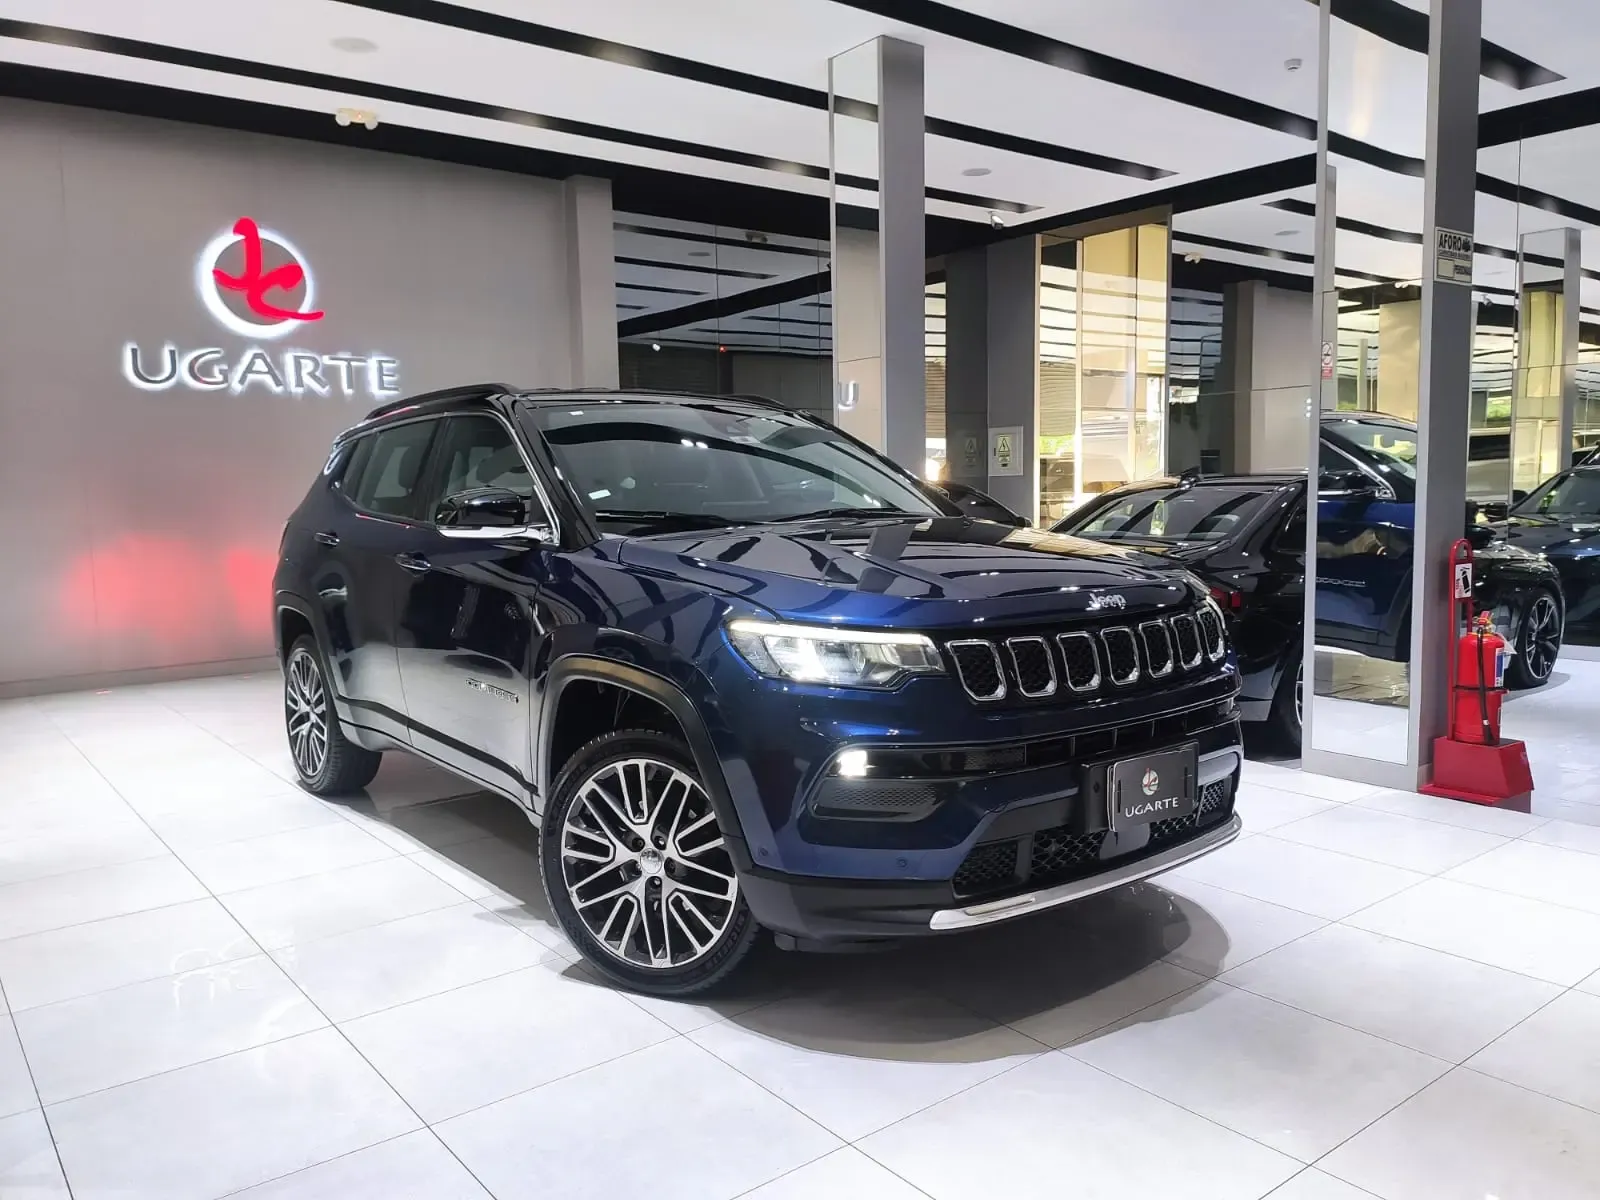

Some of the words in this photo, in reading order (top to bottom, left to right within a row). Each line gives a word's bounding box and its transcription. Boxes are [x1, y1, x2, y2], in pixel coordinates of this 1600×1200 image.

[1439, 232, 1462, 251] AFORO
[124, 344, 400, 399] UGARTE
[1086, 592, 1127, 610] Jeep
[1125, 797, 1179, 818] UGARTE
